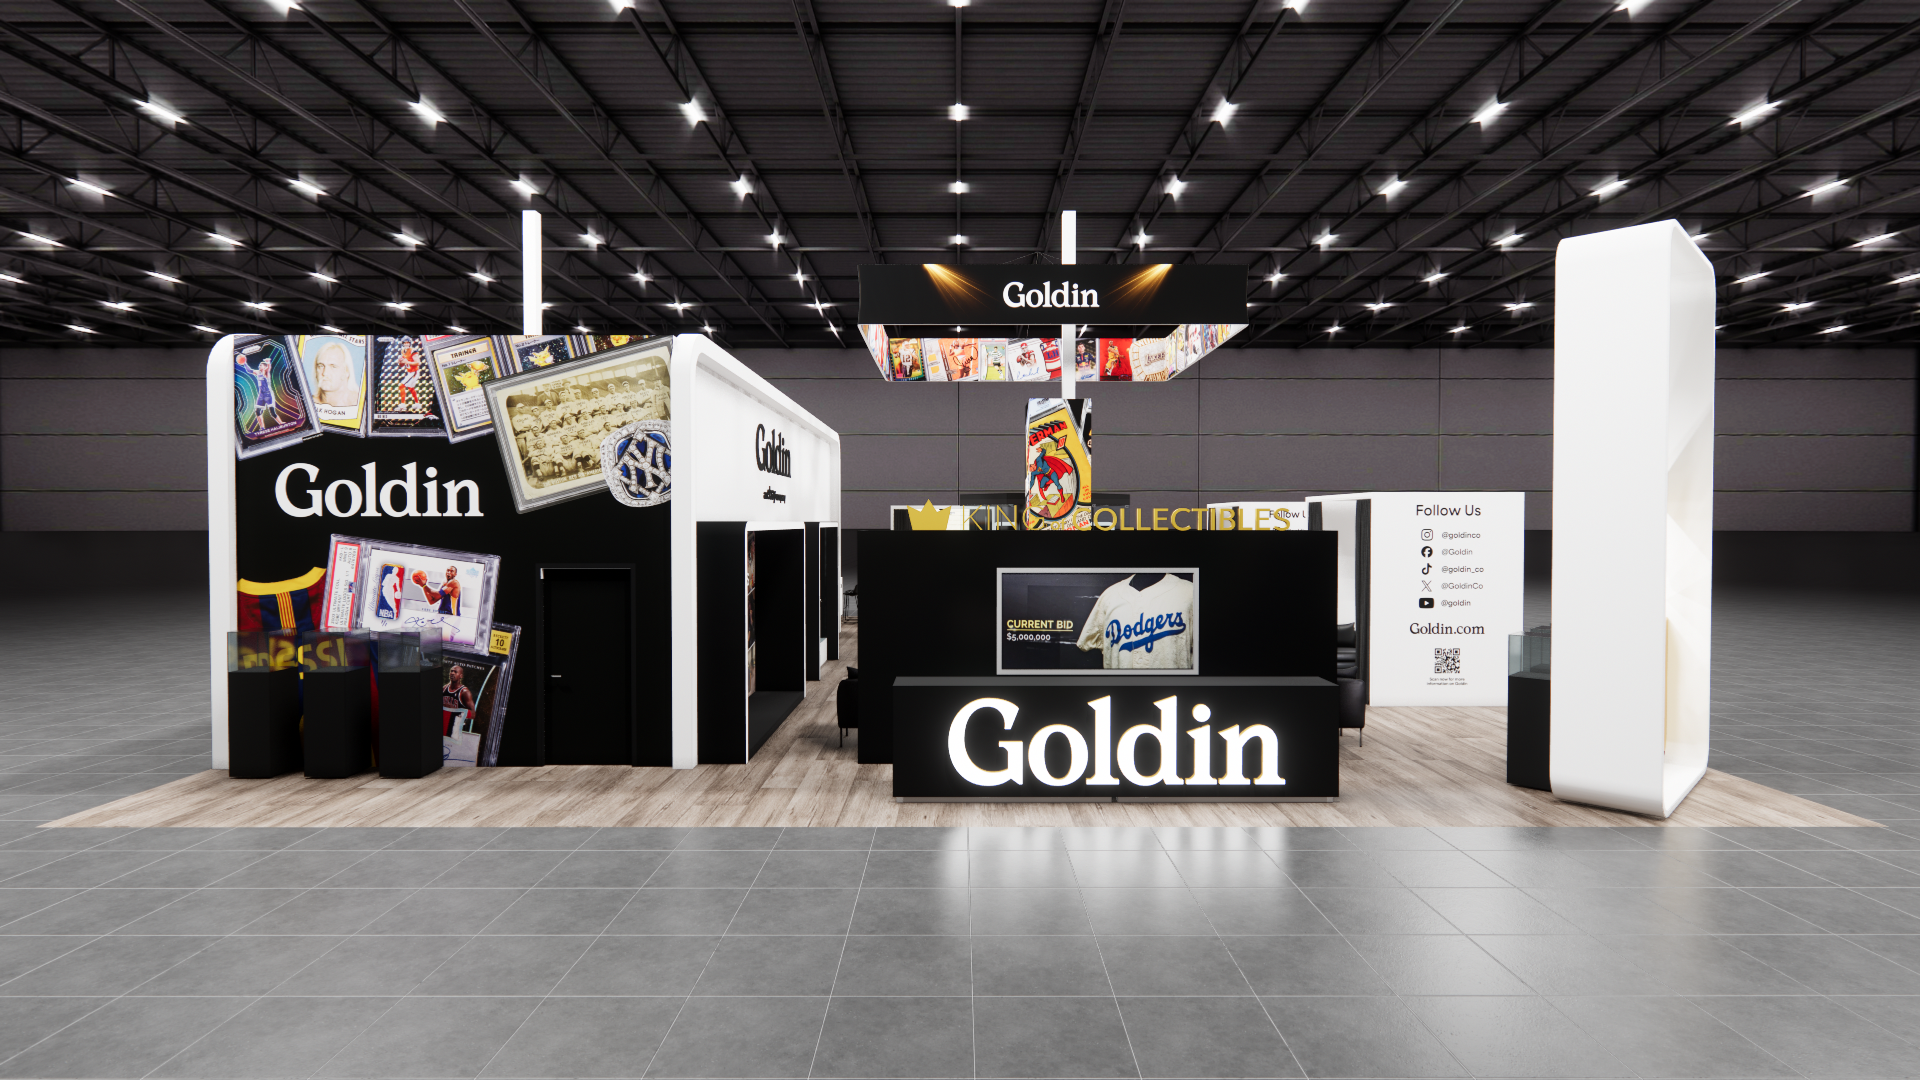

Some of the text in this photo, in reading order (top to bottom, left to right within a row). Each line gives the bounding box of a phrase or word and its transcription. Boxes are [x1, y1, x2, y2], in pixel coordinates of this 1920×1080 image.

[1002, 280, 1100, 308] Goldin
[450, 347, 477, 359] TRAINER
[901, 354, 911, 363] 12
[755, 423, 791, 478] Goldin
[275, 461, 485, 517] Goldin
[1416, 504, 1482, 516] Follow Us
[962, 504, 1291, 532] KING of COLLECTIBLES
[1441, 531, 1481, 540] @goldinco
[1441, 548, 1473, 556] @Goldin
[1441, 566, 1485, 574] @goldin_co
[1440, 582, 1484, 590] @GoldinCo
[1440, 599, 1471, 608] @goldin
[378, 608, 394, 618] NBA
[1006, 619, 1074, 629] CURRENT BID
[1409, 622, 1485, 634] Goldin.com
[1006, 633, 1051, 642] $5,000,000
[1105, 612, 1186, 653] Dodgers
[495, 638, 504, 647] 10
[948, 694, 1286, 787] Goldin
